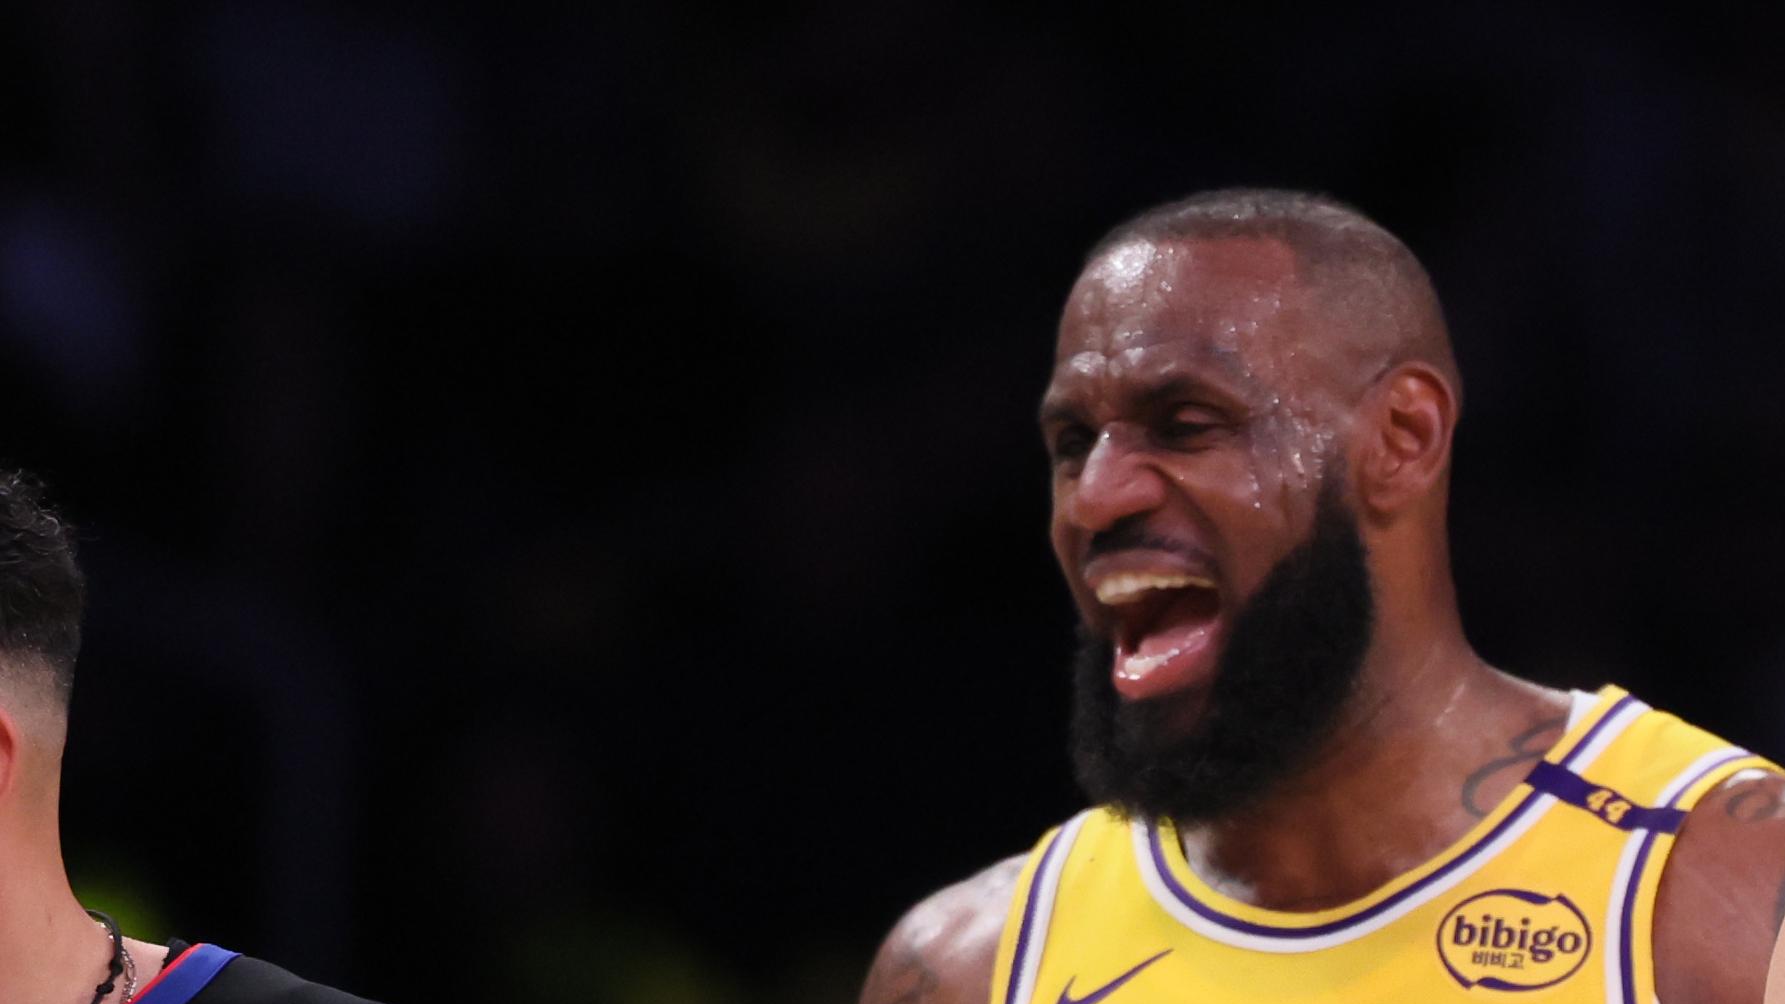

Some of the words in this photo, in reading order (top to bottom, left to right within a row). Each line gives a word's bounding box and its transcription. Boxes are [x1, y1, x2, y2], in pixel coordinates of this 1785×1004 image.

[1586, 789, 1632, 824] 44
[1453, 914, 1582, 963] bibigo
[1471, 951, 1525, 969] 비비고
